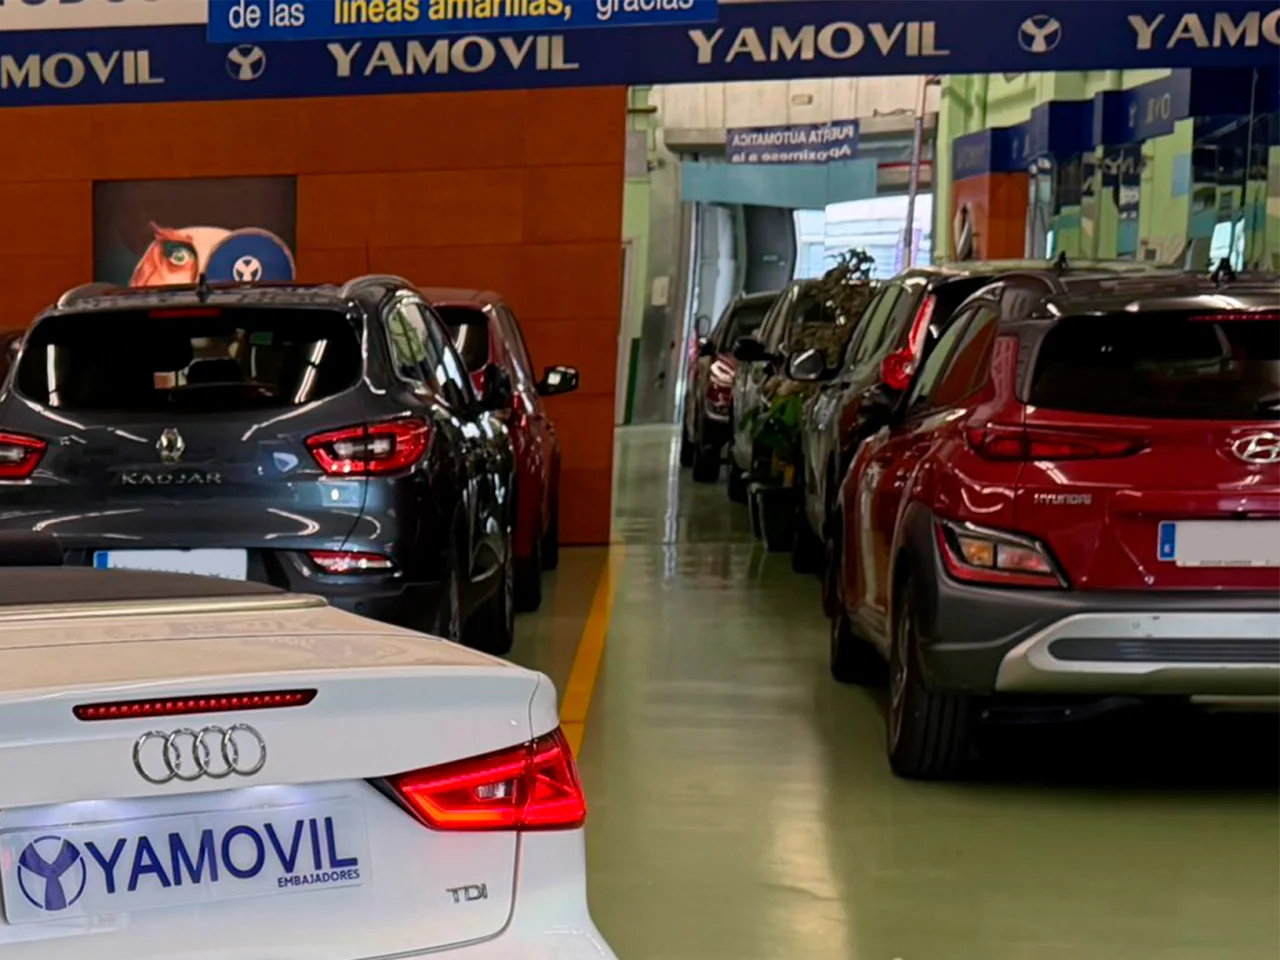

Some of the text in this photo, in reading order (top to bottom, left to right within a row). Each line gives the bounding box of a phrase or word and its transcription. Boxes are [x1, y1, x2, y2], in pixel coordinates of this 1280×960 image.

[228, 0, 262, 29] de
[269, 0, 306, 28] las
[428, 0, 572, 20] amarillas,
[687, 20, 951, 64] YAMOVIL
[327, 35, 580, 77] YAMOVIL
[121, 472, 221, 485] KADJAR
[1034, 492, 1092, 505] HYUNDAI
[83, 816, 359, 894] YAMOVIL
[277, 868, 360, 888] EMBAJADORES
[445, 883, 488, 903] TDI
